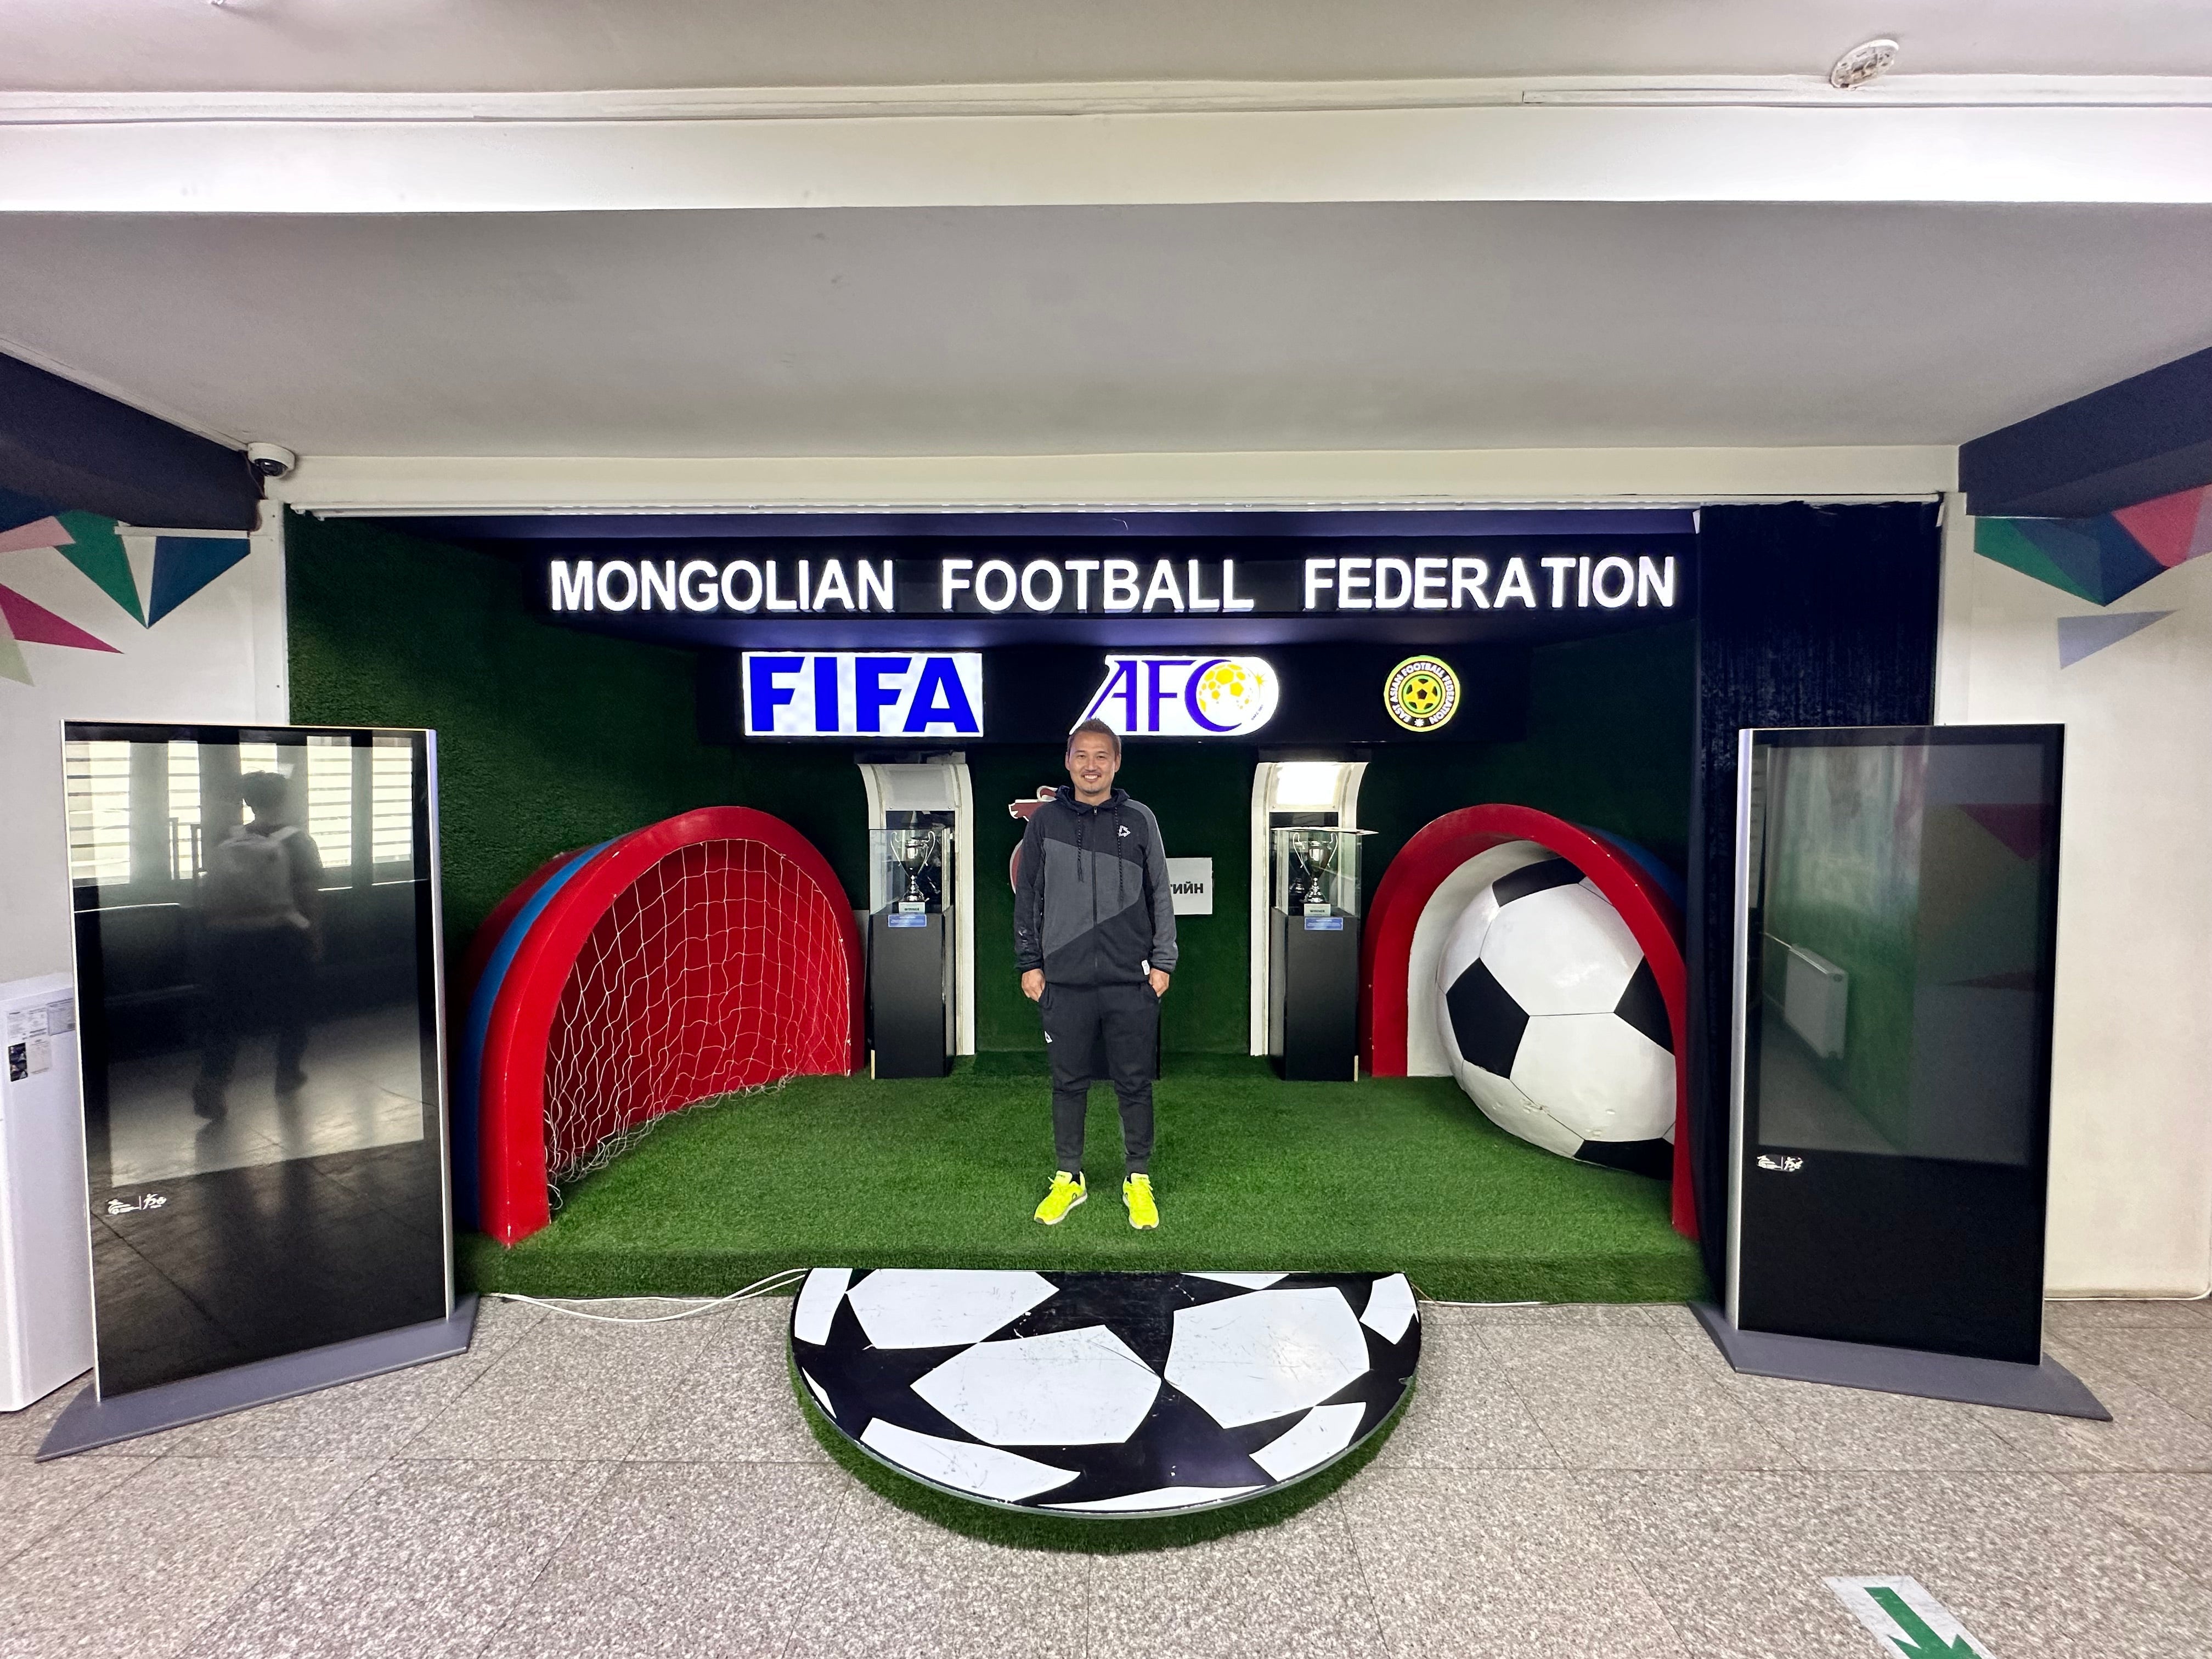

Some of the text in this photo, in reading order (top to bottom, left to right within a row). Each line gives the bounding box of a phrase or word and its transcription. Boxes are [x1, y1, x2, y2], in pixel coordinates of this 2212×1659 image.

[551, 556, 1674, 612] MONGOLIAN FOOTBALL FEDERATION
[749, 657, 980, 733] FIFA
[1086, 659, 1242, 732] AFC
[1390, 662, 1454, 724] EAST ASIAN FOOTBALL FEDERATION
[1170, 881, 1204, 894] ИЙН
